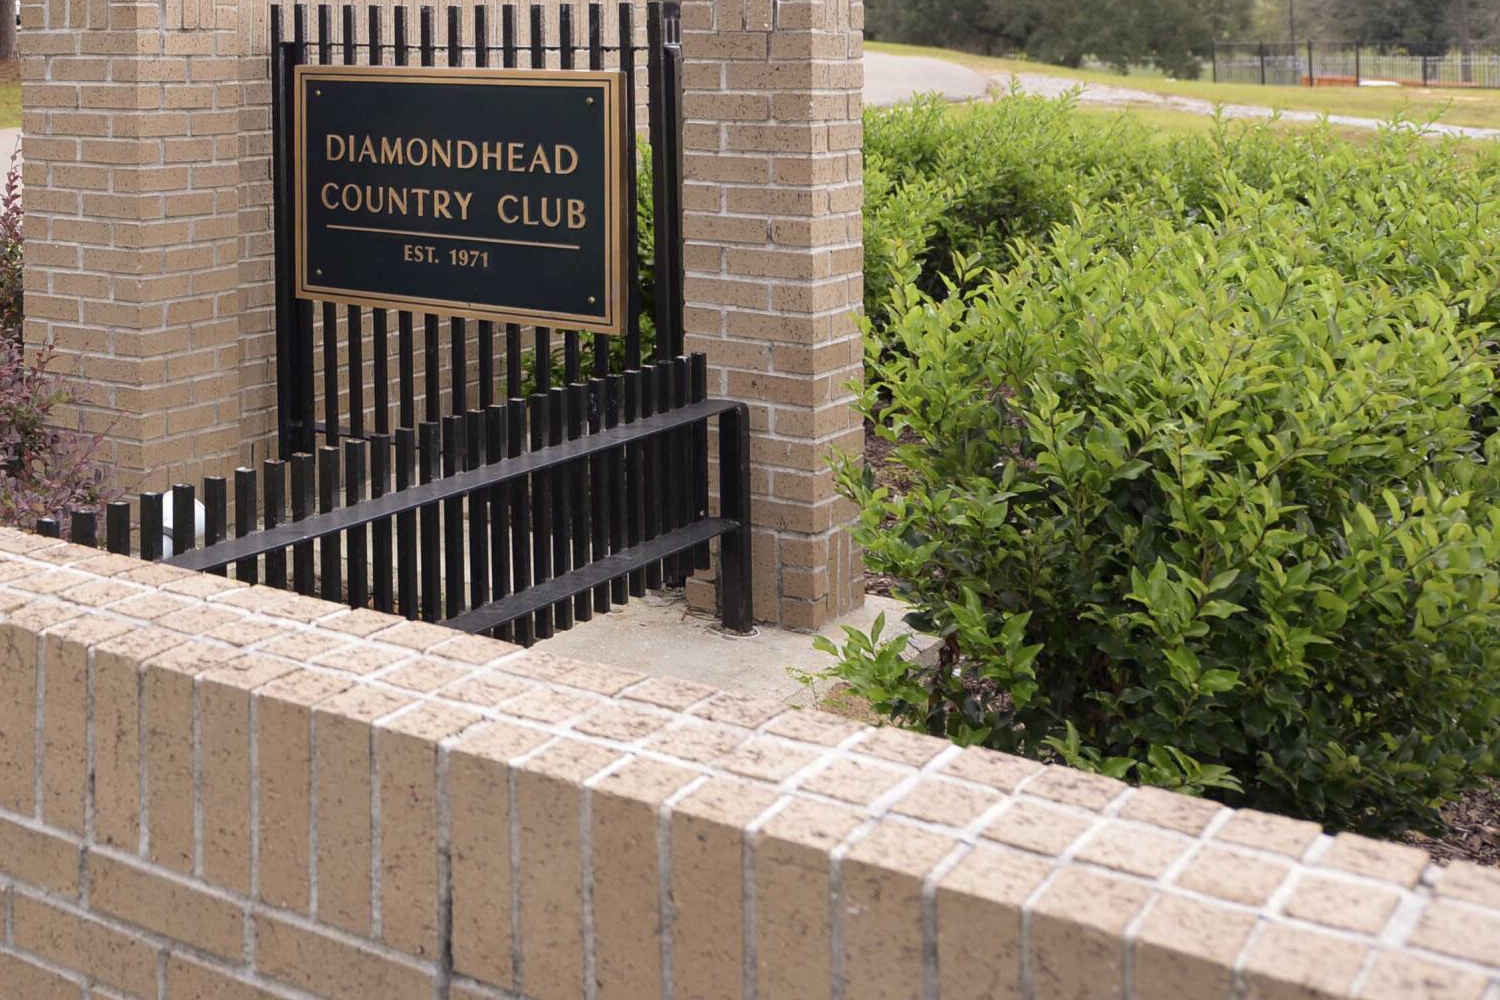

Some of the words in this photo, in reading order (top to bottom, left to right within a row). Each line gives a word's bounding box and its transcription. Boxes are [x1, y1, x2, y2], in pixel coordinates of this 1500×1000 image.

[325, 133, 579, 175] DIAMONDHEAD
[320, 182, 473, 220] COUNTRY
[496, 194, 587, 229] CLUB
[403, 244, 439, 264] EST.
[448, 249, 489, 268] 1971
